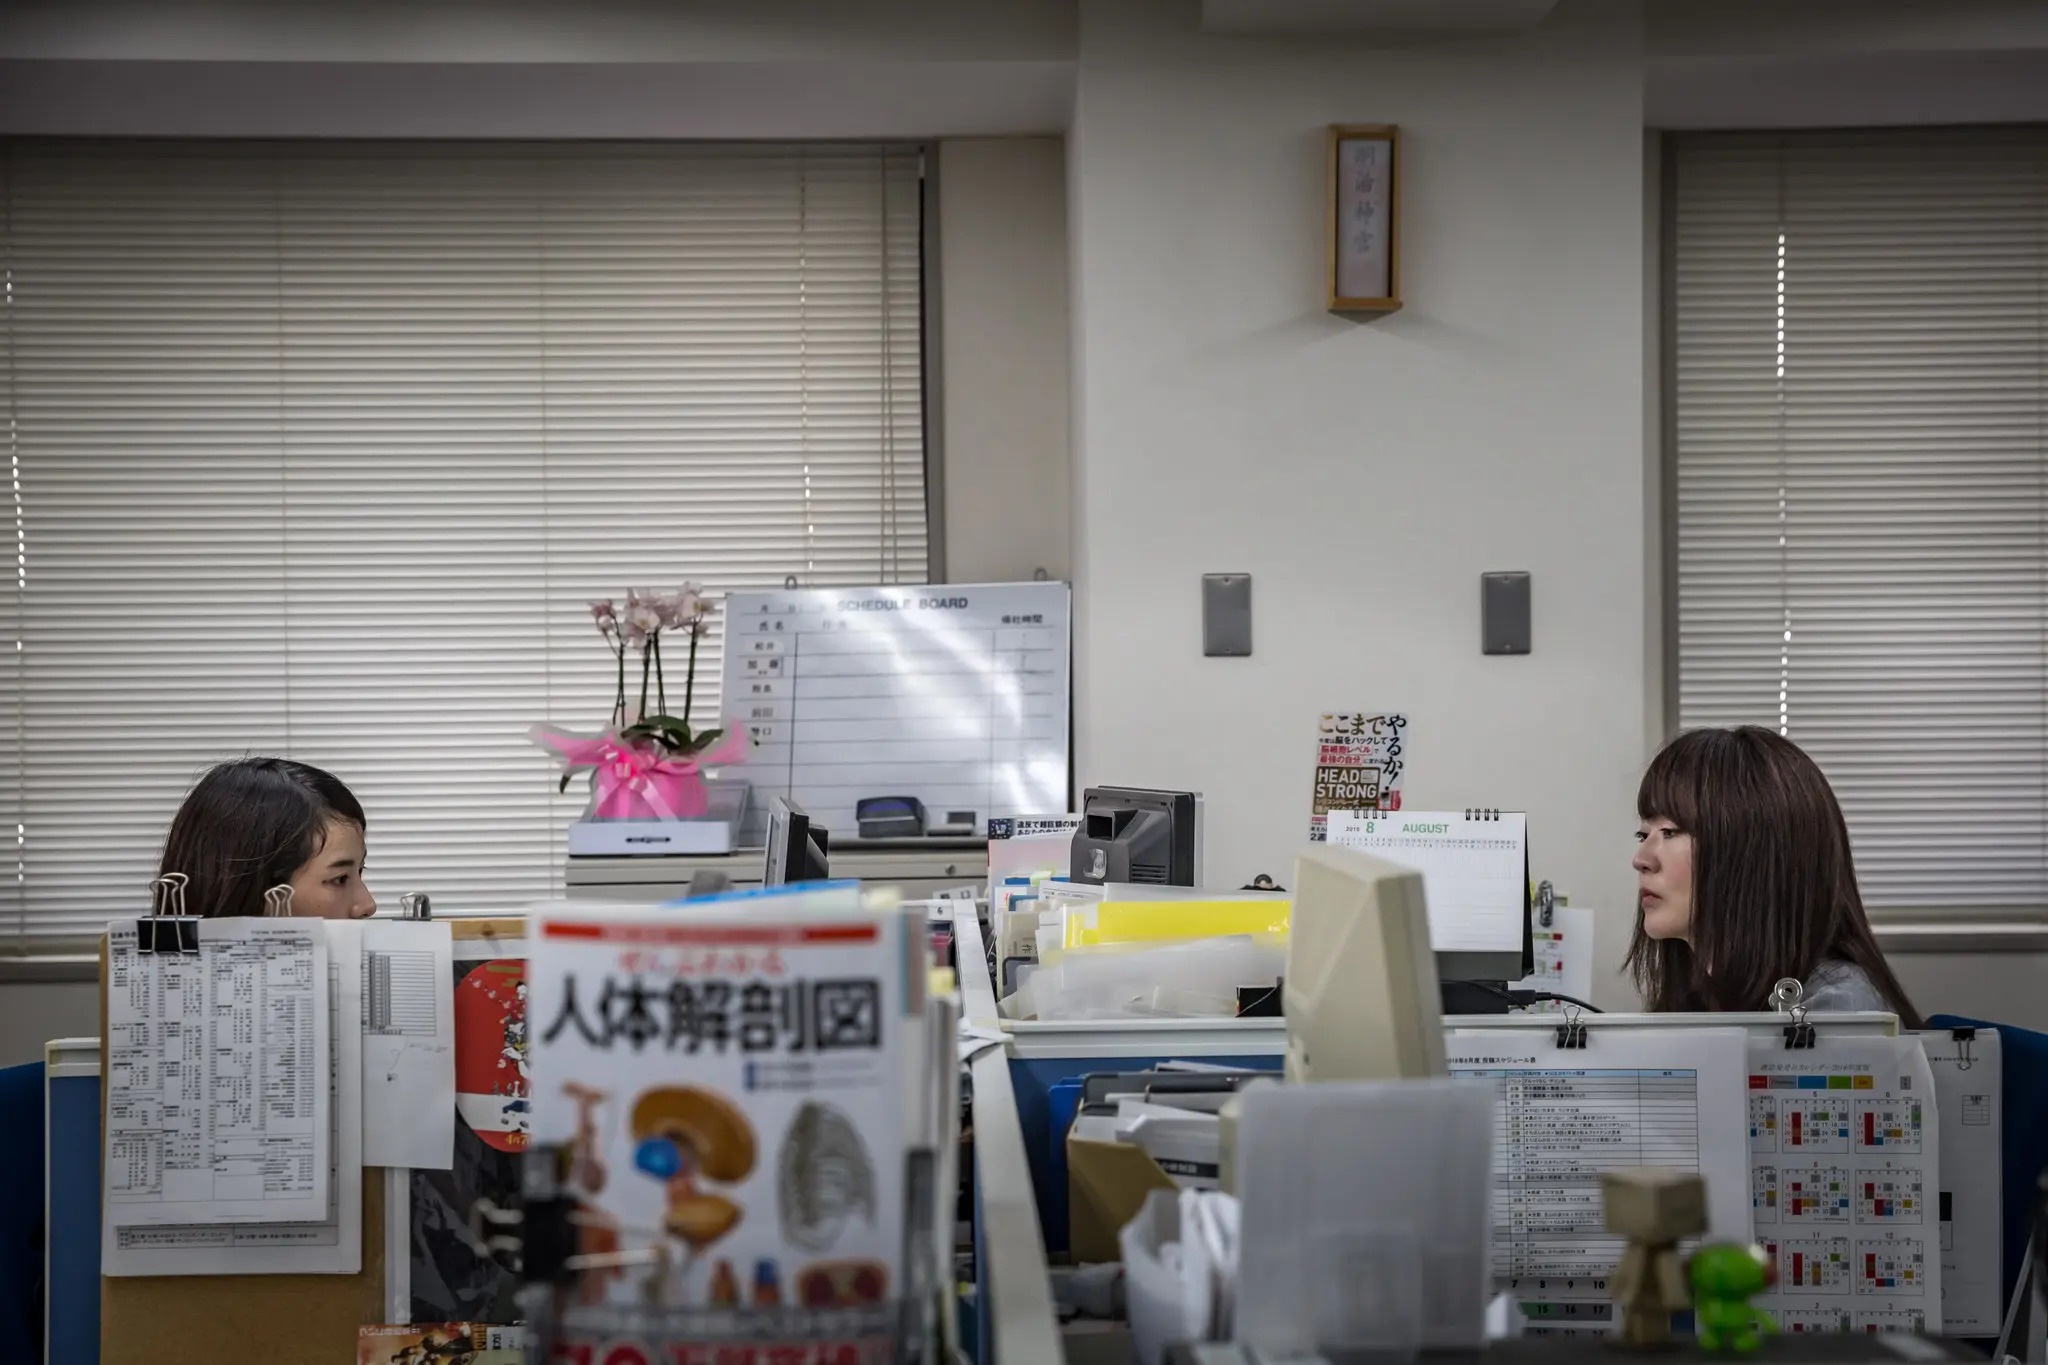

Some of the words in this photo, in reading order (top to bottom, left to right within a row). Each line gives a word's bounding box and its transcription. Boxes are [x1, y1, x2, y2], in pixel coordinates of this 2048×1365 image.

[837, 599, 912, 612] SCHEDULE
[919, 597, 968, 610] BOARD
[1320, 713, 1386, 735] ここまで
[1317, 769, 1360, 783] HEAD
[1316, 783, 1377, 799] STRONG
[1017, 820, 1082, 828] 違反で超巨額の制
[1366, 821, 1375, 834] 8
[1402, 823, 1450, 834] AUGUST
[543, 973, 882, 1056] 人体解剖図
[1512, 1280, 1518, 1288] 7
[1540, 1280, 1546, 1288] 8
[1567, 1280, 1573, 1289] 9
[1593, 1281, 1605, 1289] 10
[1537, 1305, 1549, 1314] 15
[1565, 1305, 1576, 1314] 16
[1593, 1306, 1605, 1314] 17
